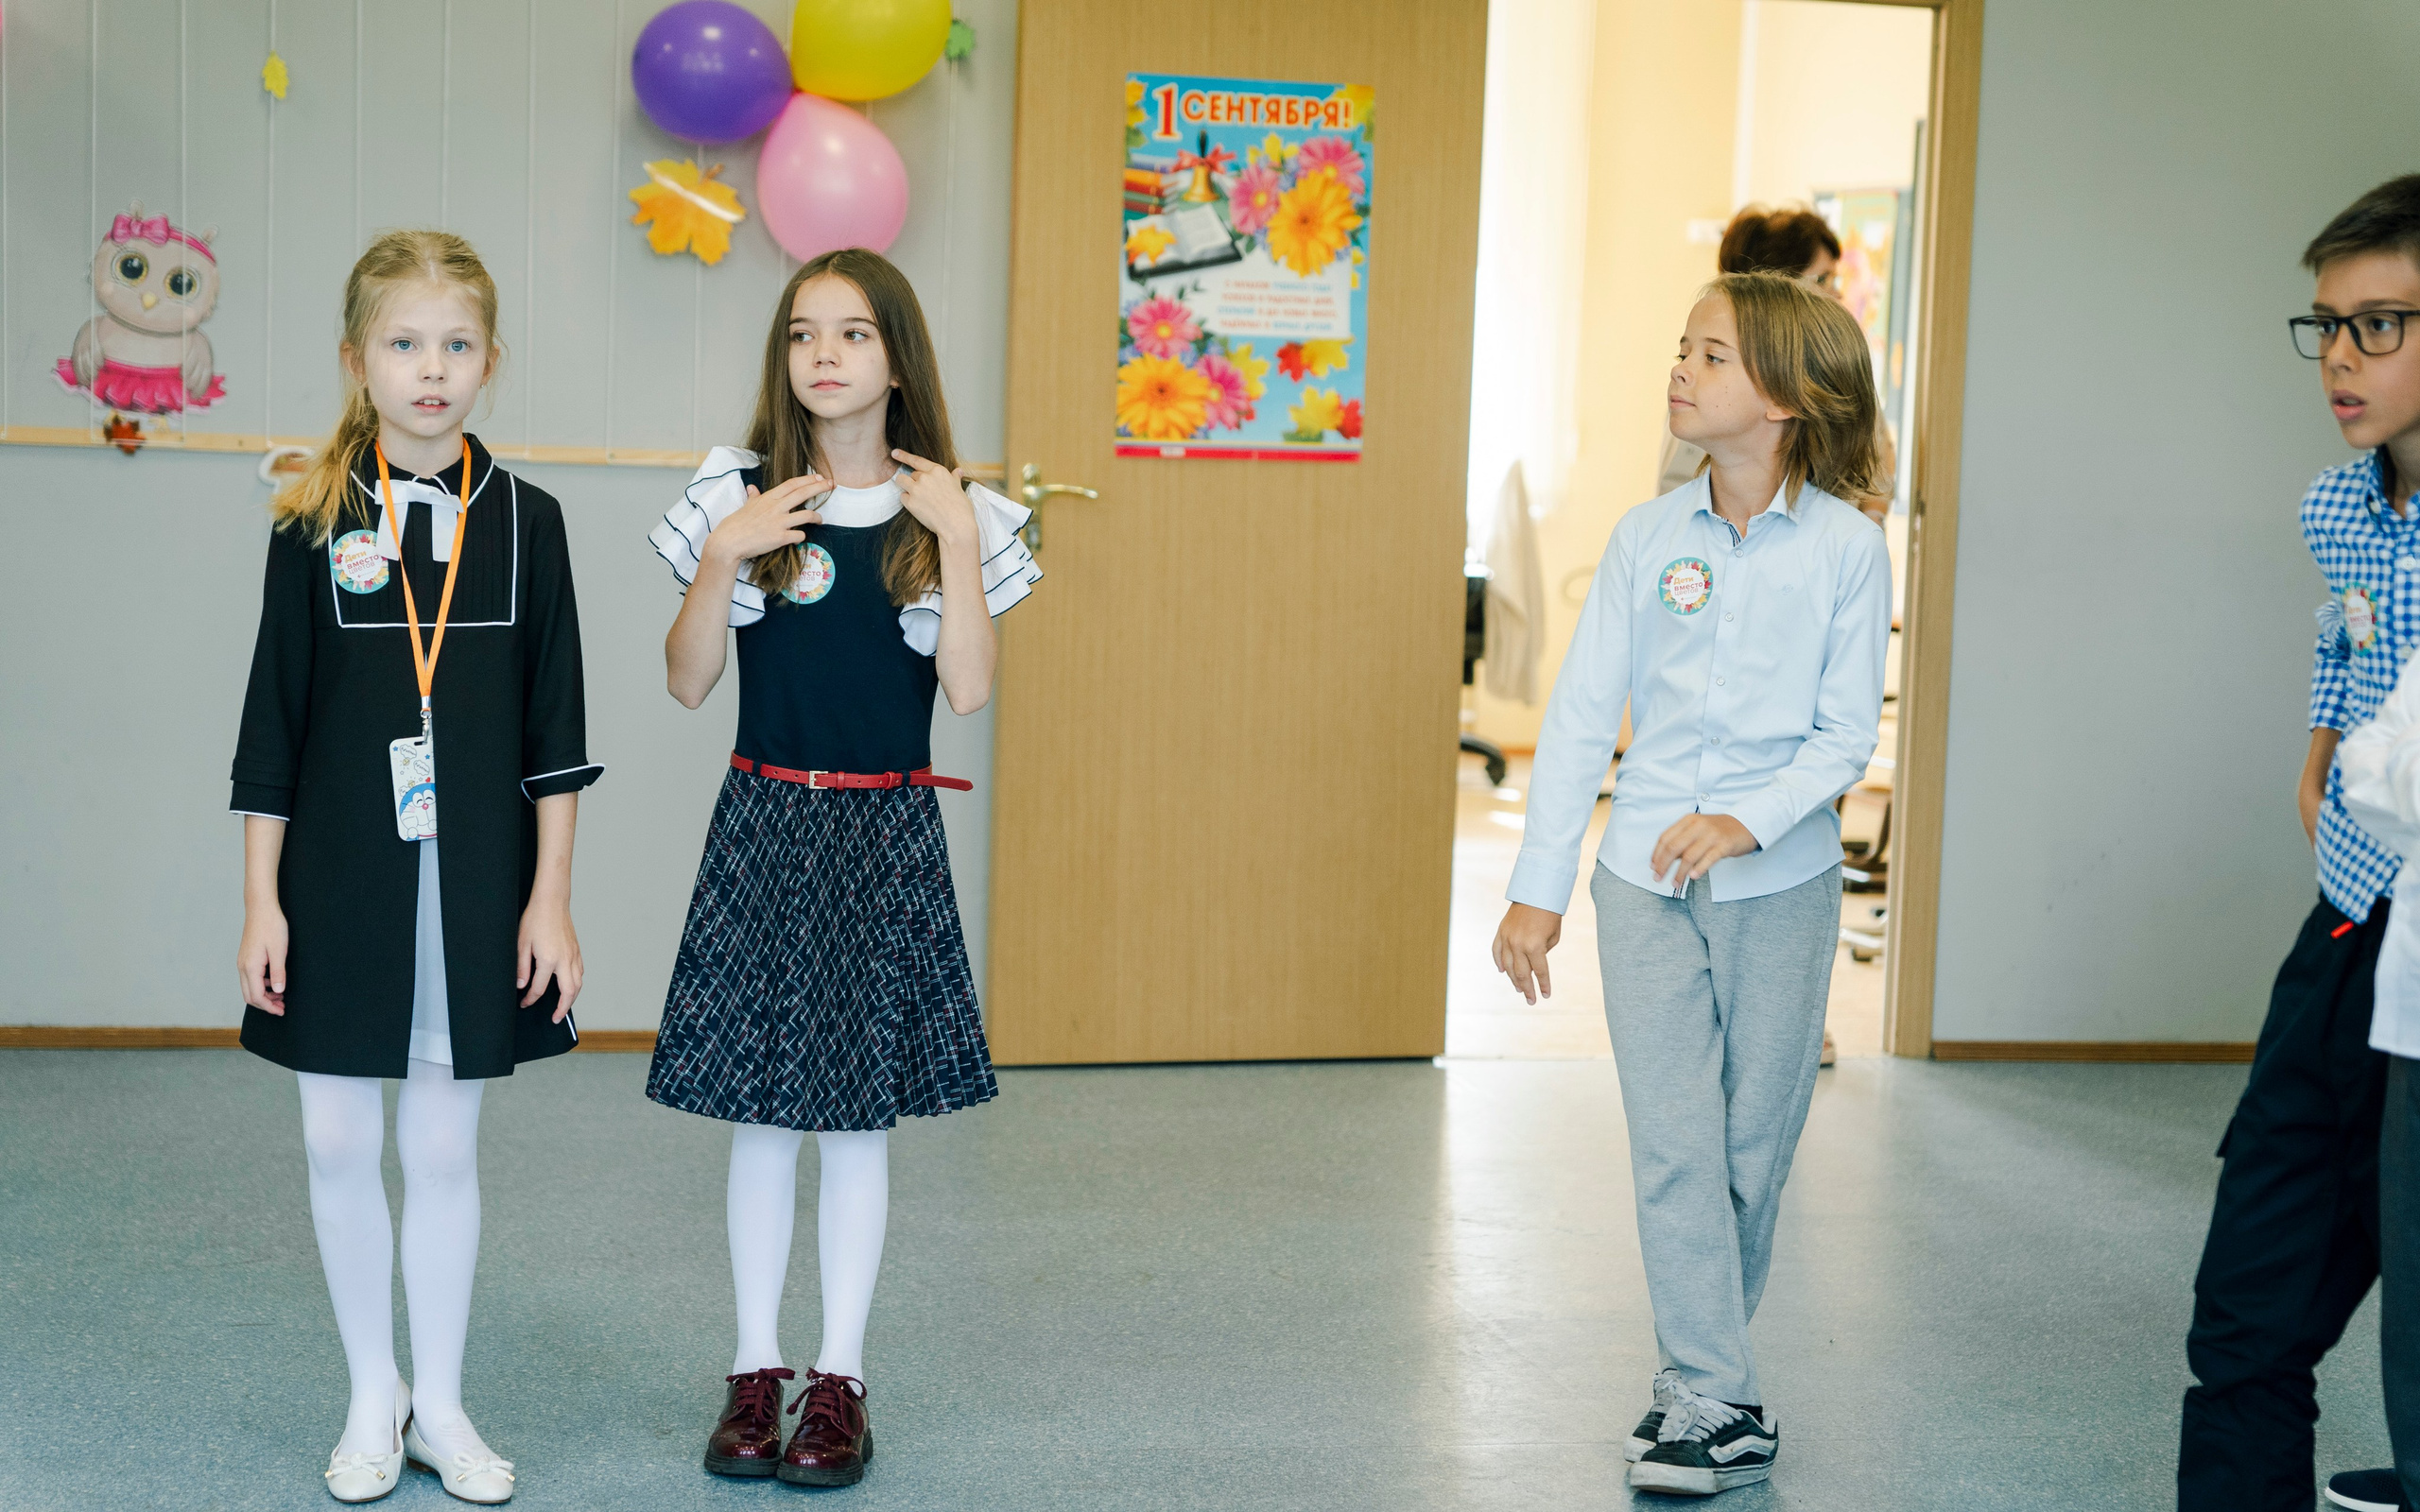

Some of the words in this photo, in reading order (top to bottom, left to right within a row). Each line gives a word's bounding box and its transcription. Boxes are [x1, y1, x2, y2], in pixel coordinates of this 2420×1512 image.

[1153, 84, 1181, 139] 1
[1182, 93, 1352, 129] СЕНТЯБРЯ!
[344, 551, 367, 563] Дети
[346, 554, 379, 570] вместо
[348, 561, 375, 575] цветов
[1673, 576, 1694, 585] Дети
[1674, 581, 1703, 592] вместо
[1674, 587, 1699, 596] цветов
